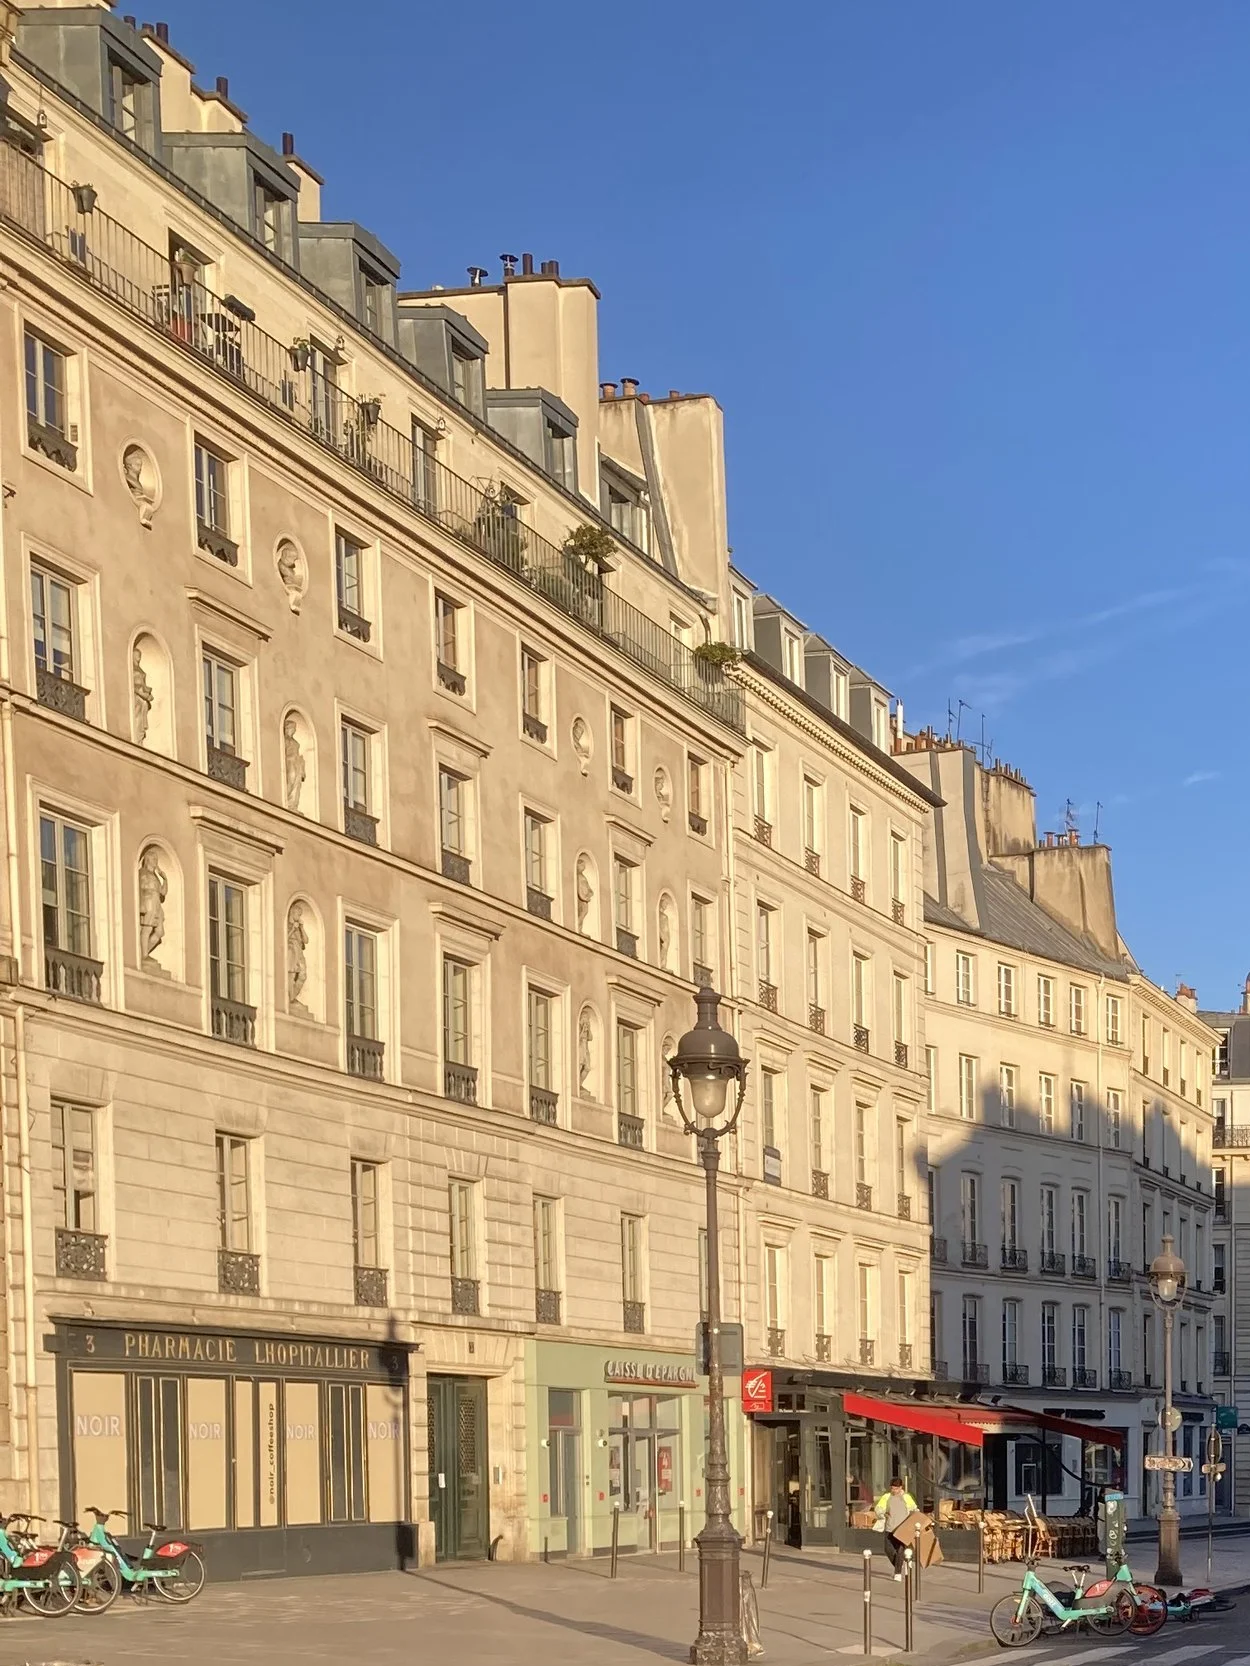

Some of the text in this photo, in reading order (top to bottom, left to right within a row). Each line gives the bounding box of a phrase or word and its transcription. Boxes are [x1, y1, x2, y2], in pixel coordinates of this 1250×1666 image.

[85, 1333, 399, 1370] 3 PHARMACIE LHOPITALLIER 3
[607, 1361, 644, 1378] CAISSE
[76, 1415, 121, 1437] NOIR
[189, 1423, 222, 1440] NOIR
[287, 1424, 316, 1440] NOIR
[368, 1421, 401, 1440] NOIR
